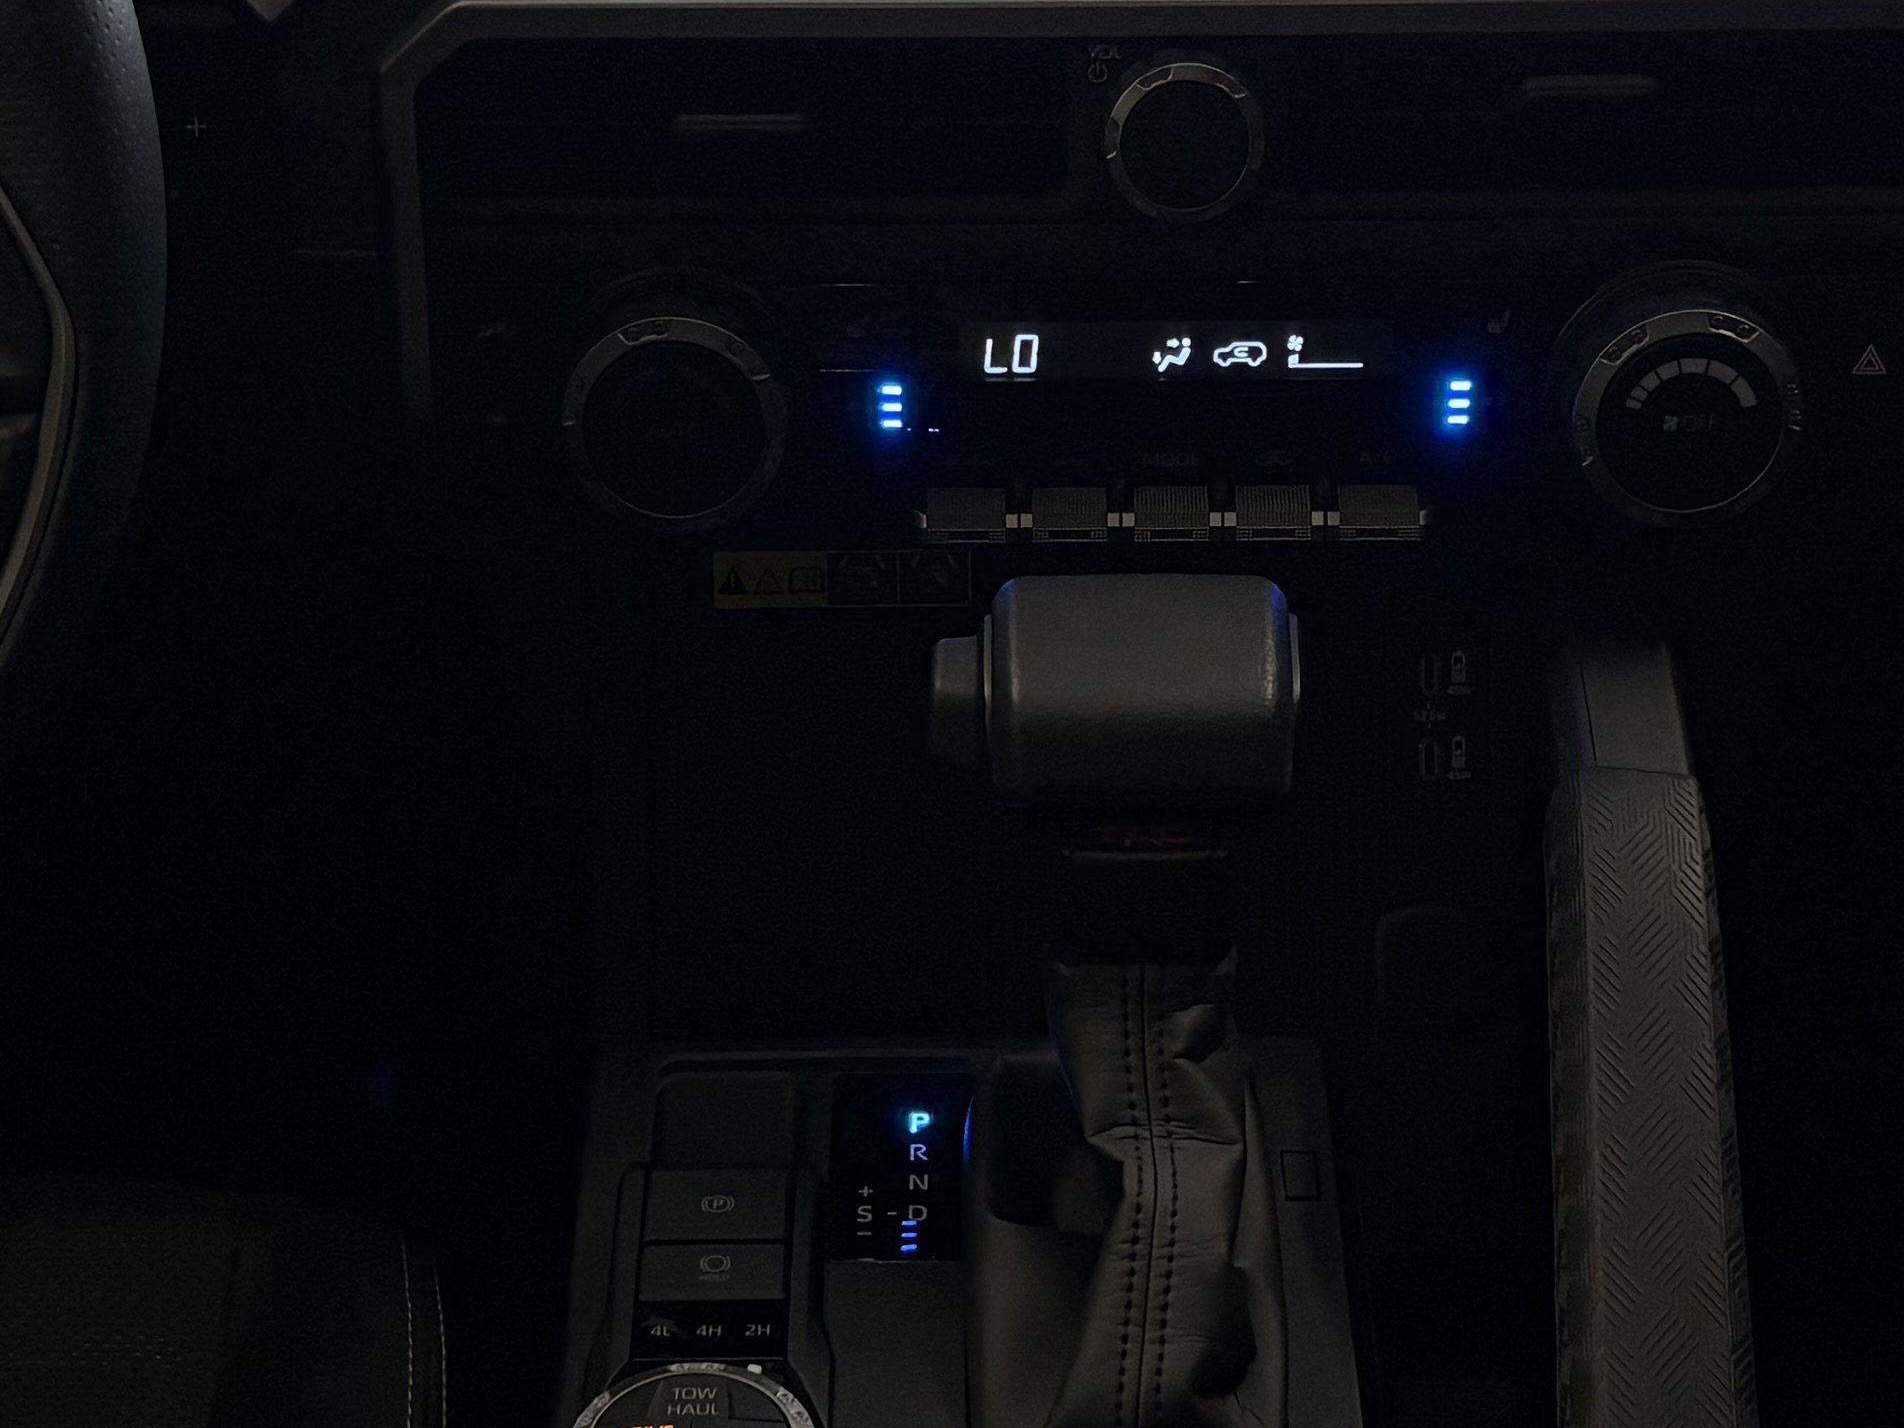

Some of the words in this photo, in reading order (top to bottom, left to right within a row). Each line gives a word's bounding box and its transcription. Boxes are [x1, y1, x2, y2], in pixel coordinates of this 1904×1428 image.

[908, 1112, 932, 1134] P
[909, 1143, 929, 1161] R
[909, 1173, 929, 1191] N
[856, 1205, 873, 1223] S
[908, 1204, 928, 1222] D
[696, 1324, 722, 1337] 4H
[744, 1323, 771, 1337] 2H
[672, 1387, 718, 1401] TOW
[667, 1403, 720, 1417] HAUL
